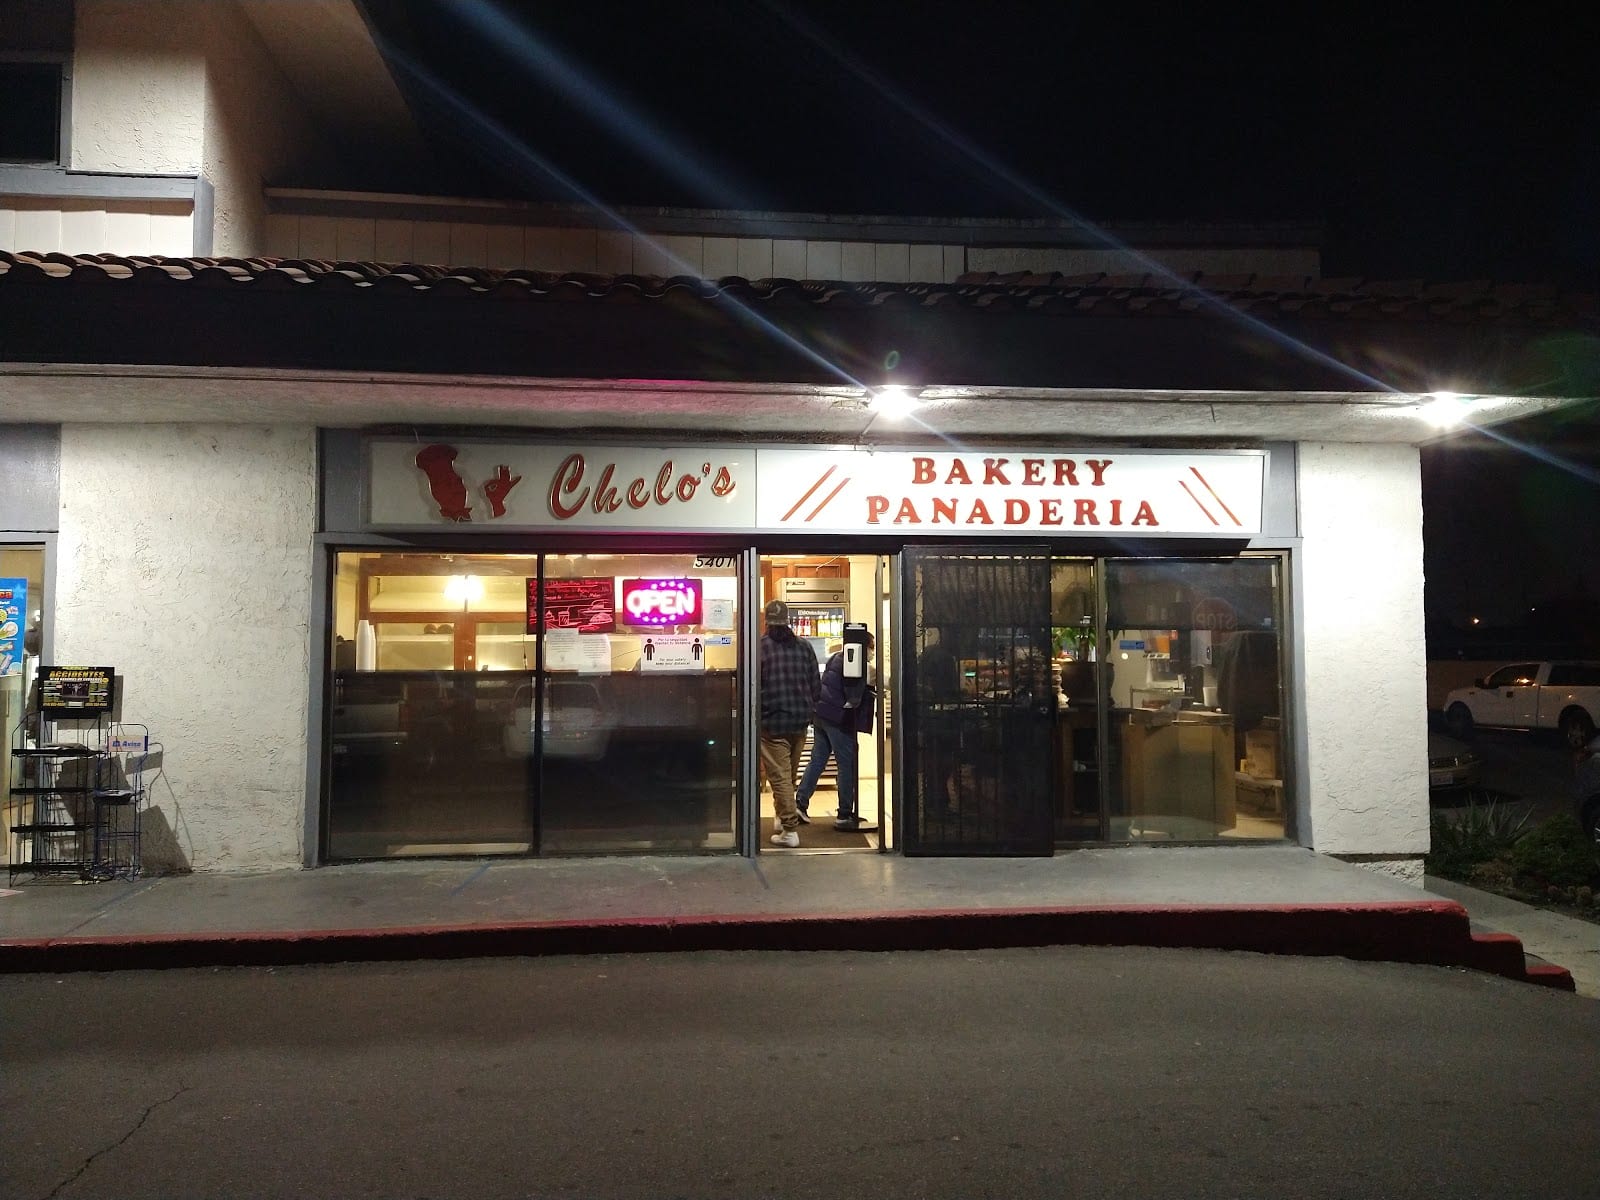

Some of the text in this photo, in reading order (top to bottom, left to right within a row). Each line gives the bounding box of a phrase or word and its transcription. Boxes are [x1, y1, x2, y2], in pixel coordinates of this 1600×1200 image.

[549, 452, 737, 520] Chelo's
[911, 456, 1114, 487] BAKERY
[865, 494, 1160, 527] PANADERIA
[626, 587, 696, 616] OPEN
[49, 670, 105, 678] ACCIDENTES
